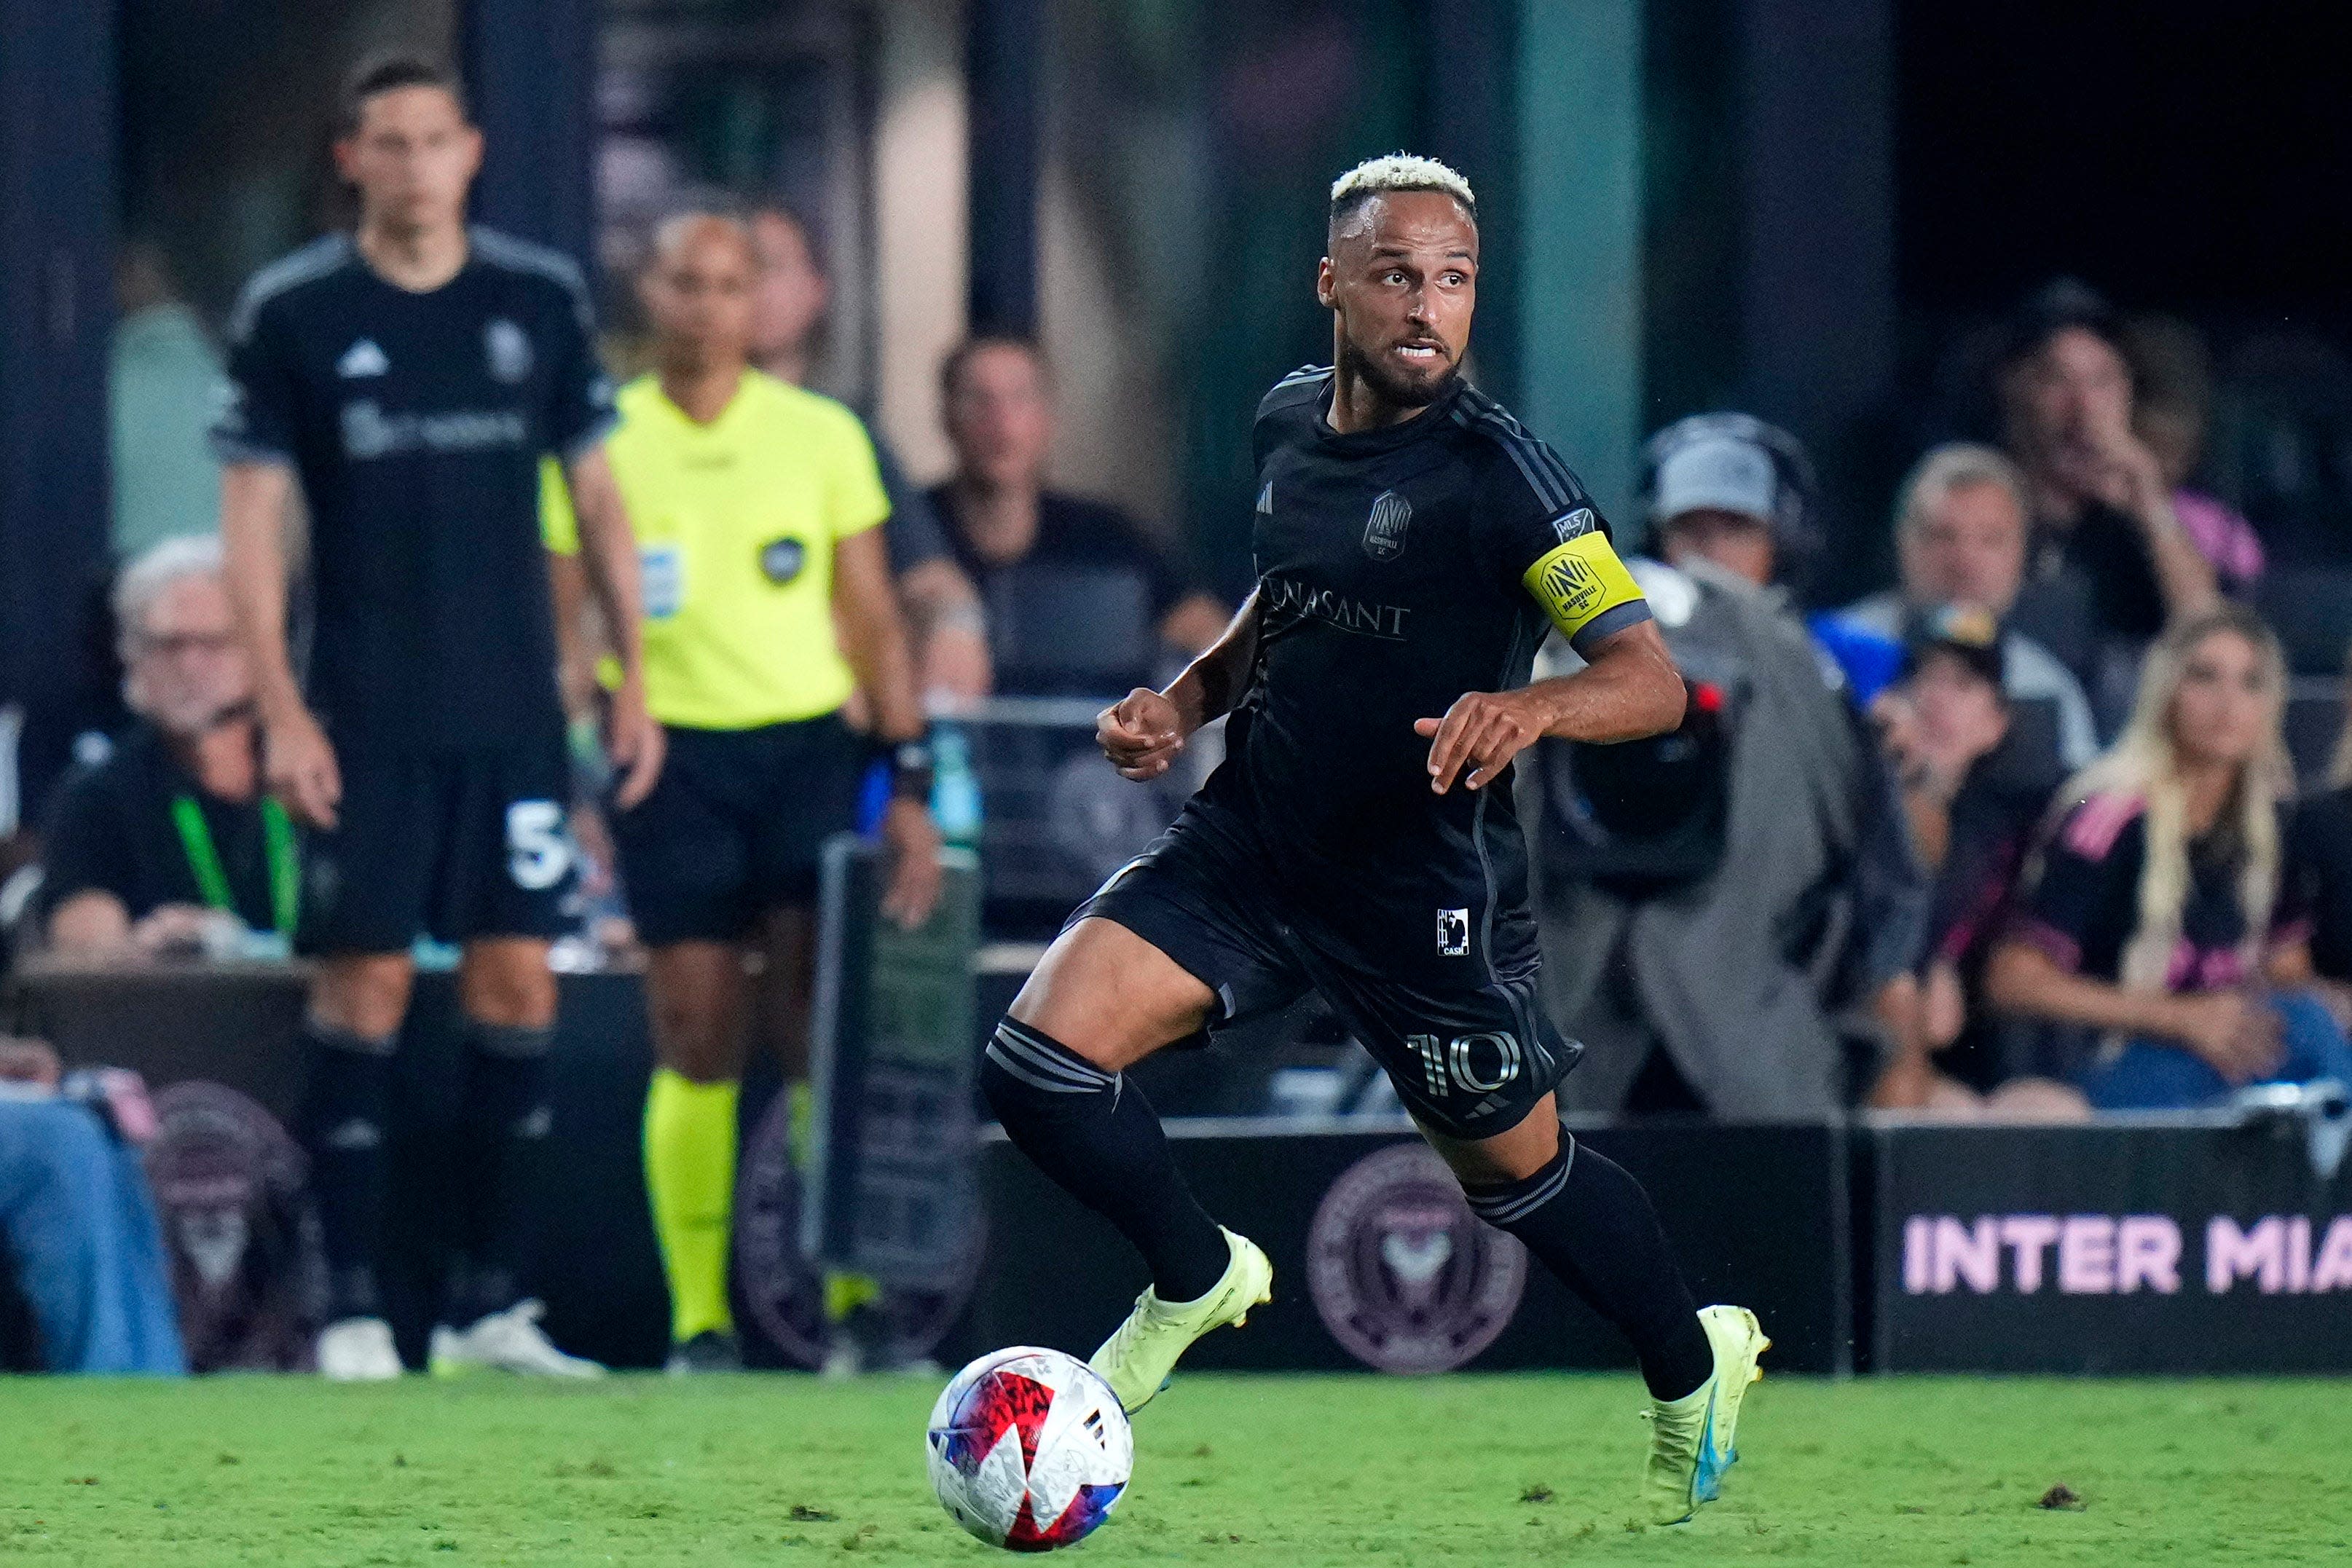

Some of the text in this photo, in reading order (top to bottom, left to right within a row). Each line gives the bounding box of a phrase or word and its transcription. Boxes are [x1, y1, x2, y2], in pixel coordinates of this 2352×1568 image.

[1557, 516, 1581, 533] MLS
[1562, 585, 1598, 612] NASHVILLE
[1578, 599, 1589, 610] SC
[508, 800, 569, 889] 5
[1444, 947, 1463, 955] CASH
[1406, 1031, 1521, 1097] 10
[1902, 1213, 2182, 1295] INTER
